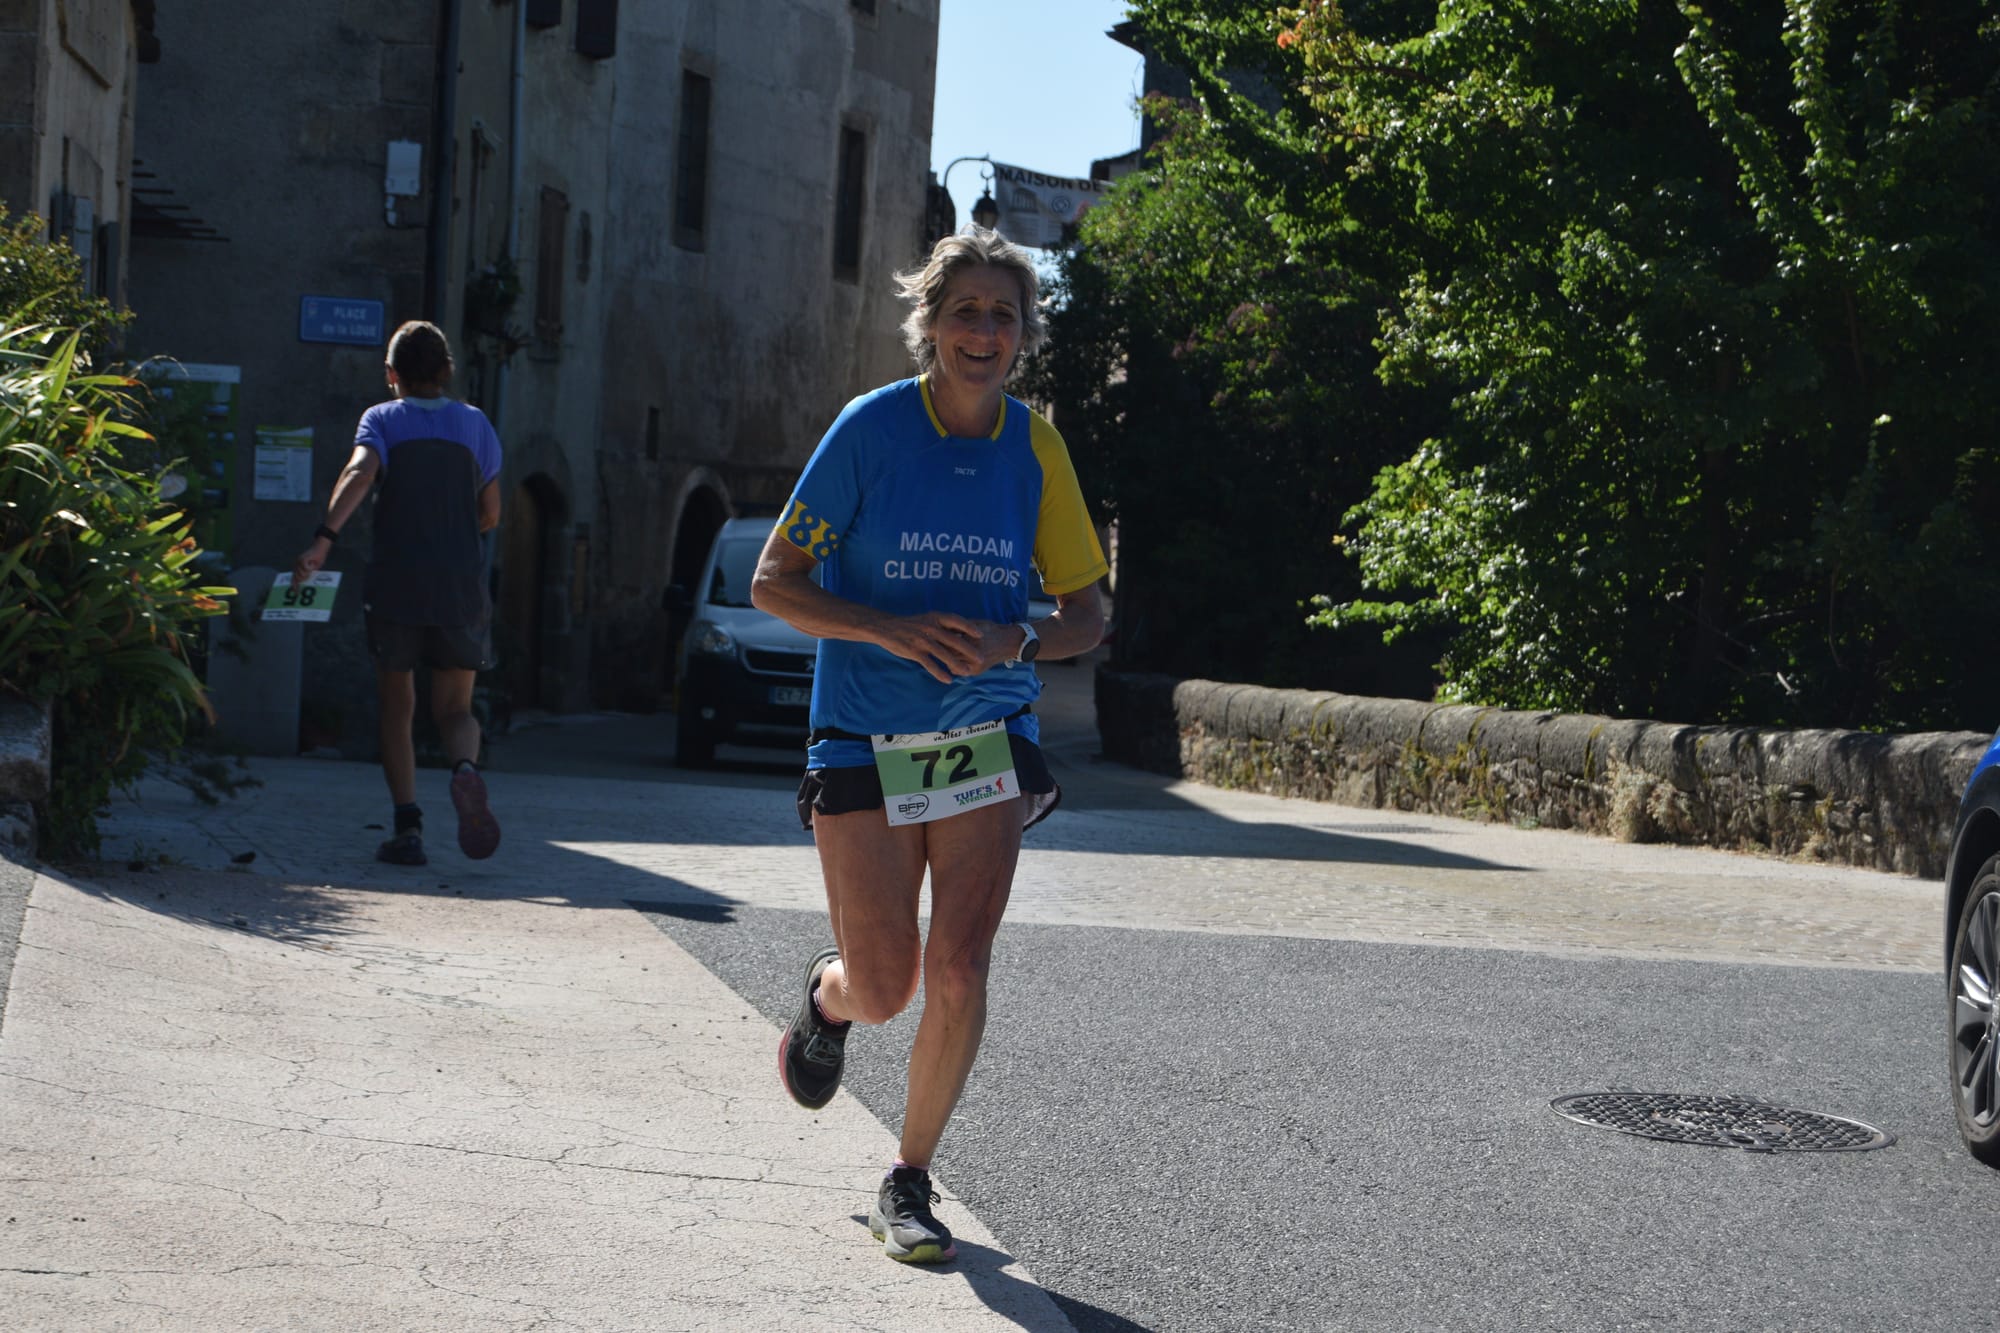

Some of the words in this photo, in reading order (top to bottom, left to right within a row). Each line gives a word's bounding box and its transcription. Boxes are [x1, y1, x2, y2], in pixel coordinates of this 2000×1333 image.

[999, 167, 1072, 189] MAISON
[900, 532, 1013, 559] MACADAM
[884, 560, 943, 580] CLUB
[950, 560, 1020, 588] NÎMOIS
[911, 745, 978, 788] 72
[953, 784, 992, 802] TUFF'S
[898, 802, 925, 813] BFP
